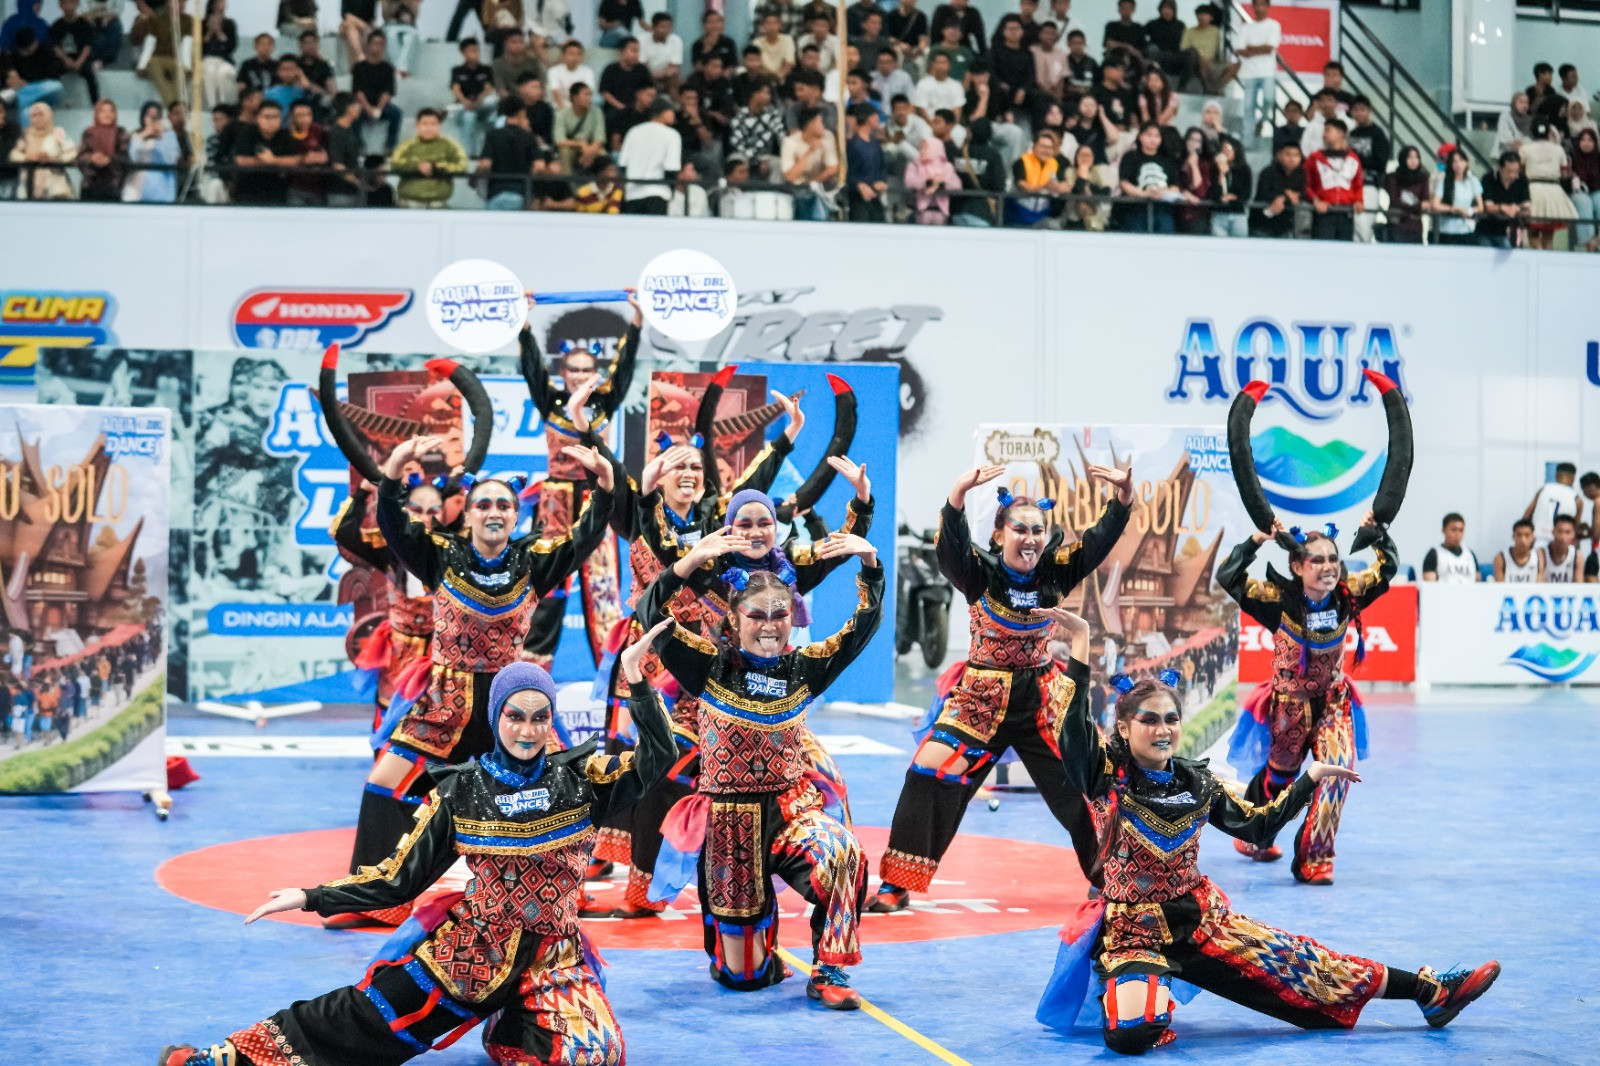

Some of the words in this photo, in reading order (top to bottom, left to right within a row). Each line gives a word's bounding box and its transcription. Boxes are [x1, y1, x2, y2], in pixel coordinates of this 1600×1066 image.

[644, 275, 690, 292] AQUA
[703, 277, 726, 287] DBL
[432, 285, 480, 304] AQUA
[493, 285, 517, 296] DBL
[1, 297, 107, 323] CUMA
[279, 303, 372, 319] HONDA
[653, 291, 719, 320] DANCE
[441, 301, 509, 332] DANCE
[278, 328, 324, 349] DBL
[1168, 321, 1410, 421] AQUA
[999, 441, 1046, 458] TORAJA
[1185, 435, 1217, 452] AQUA
[43, 463, 130, 525] SOLO
[1135, 478, 1212, 535] SOLO
[223, 611, 300, 628] DINGIN
[1494, 595, 1600, 640] AQUA
[500, 799, 544, 817] DANCE
